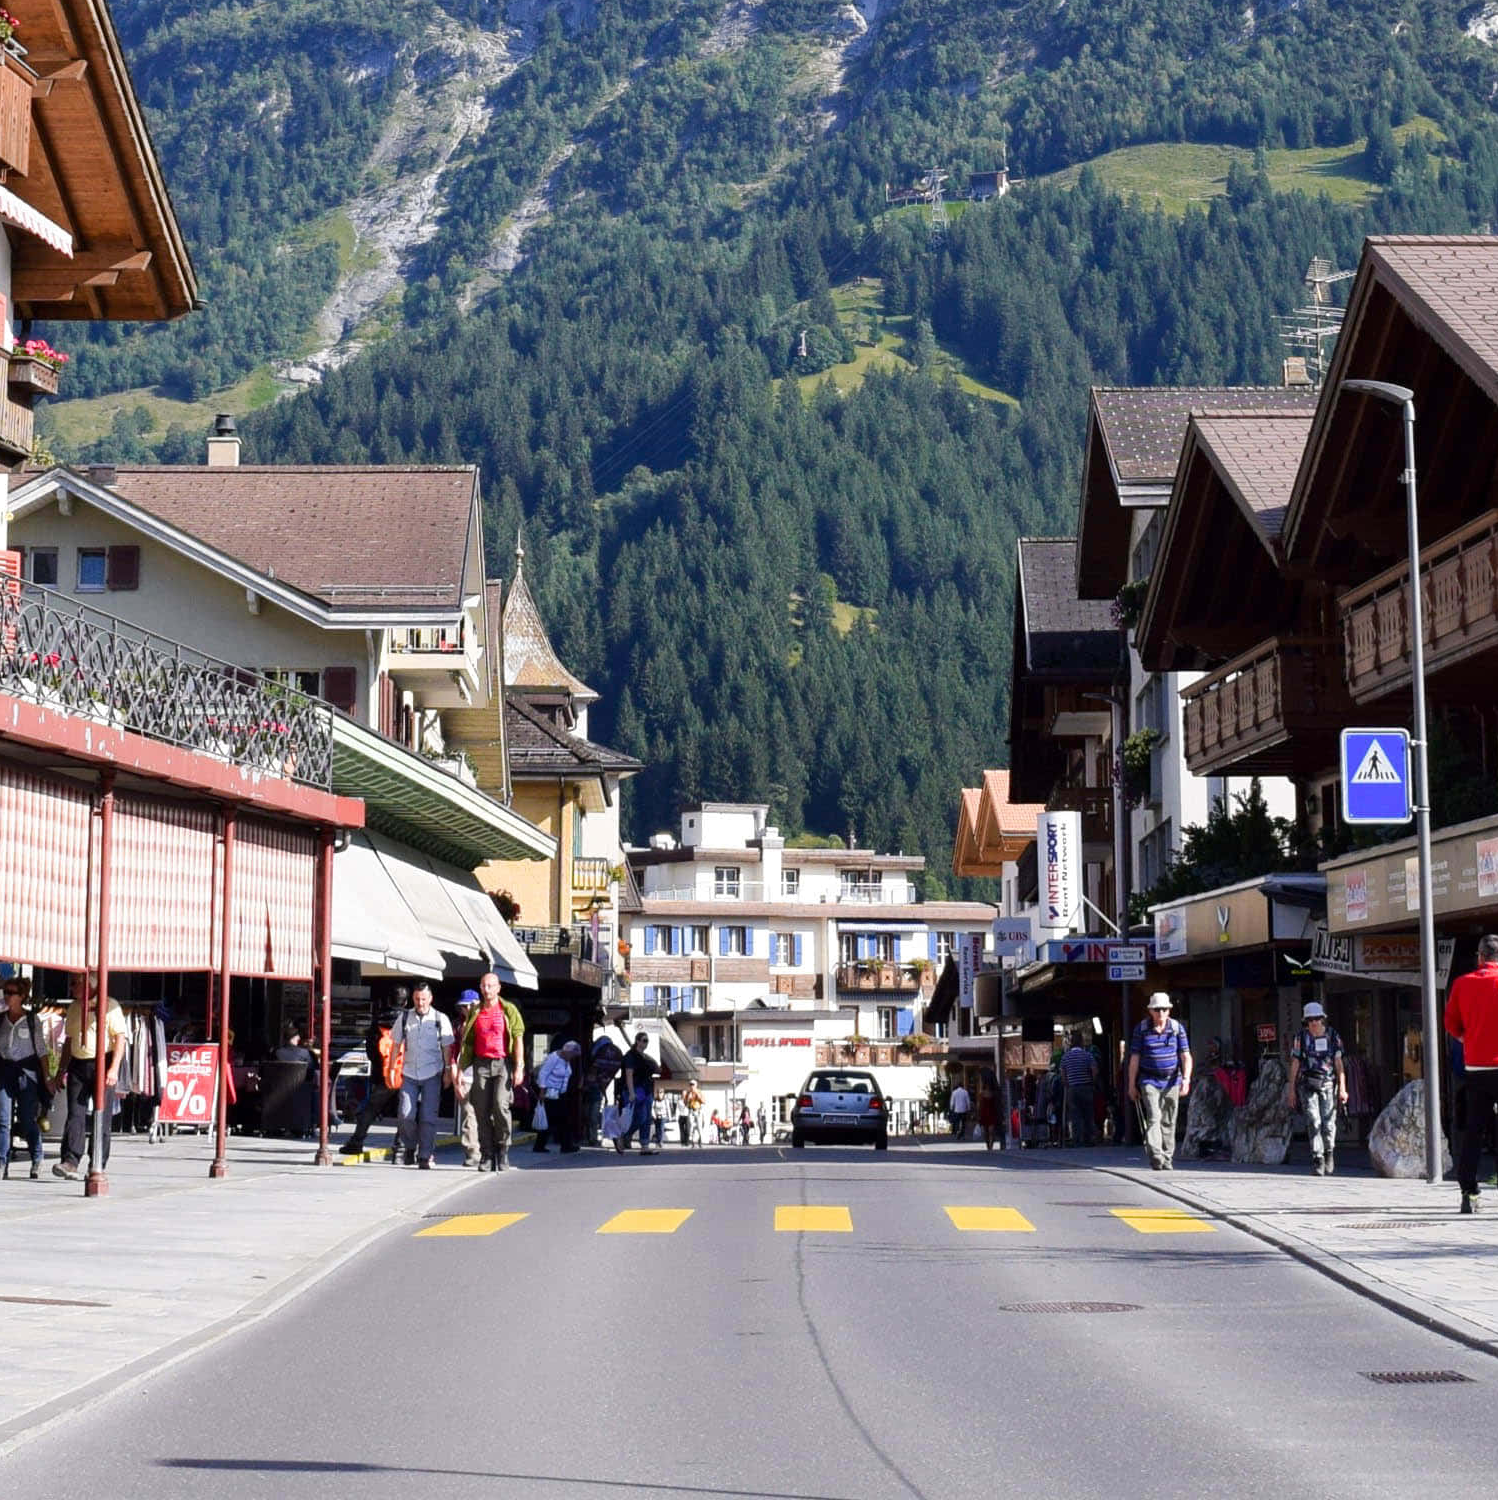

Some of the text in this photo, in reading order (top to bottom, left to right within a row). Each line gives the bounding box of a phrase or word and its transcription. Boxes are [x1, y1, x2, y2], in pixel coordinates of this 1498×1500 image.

[1047, 822, 1059, 904] INTERSPORT
[1009, 932, 1028, 941] UBS
[170, 1050, 212, 1064] SALE
[166, 1078, 206, 1117] %
